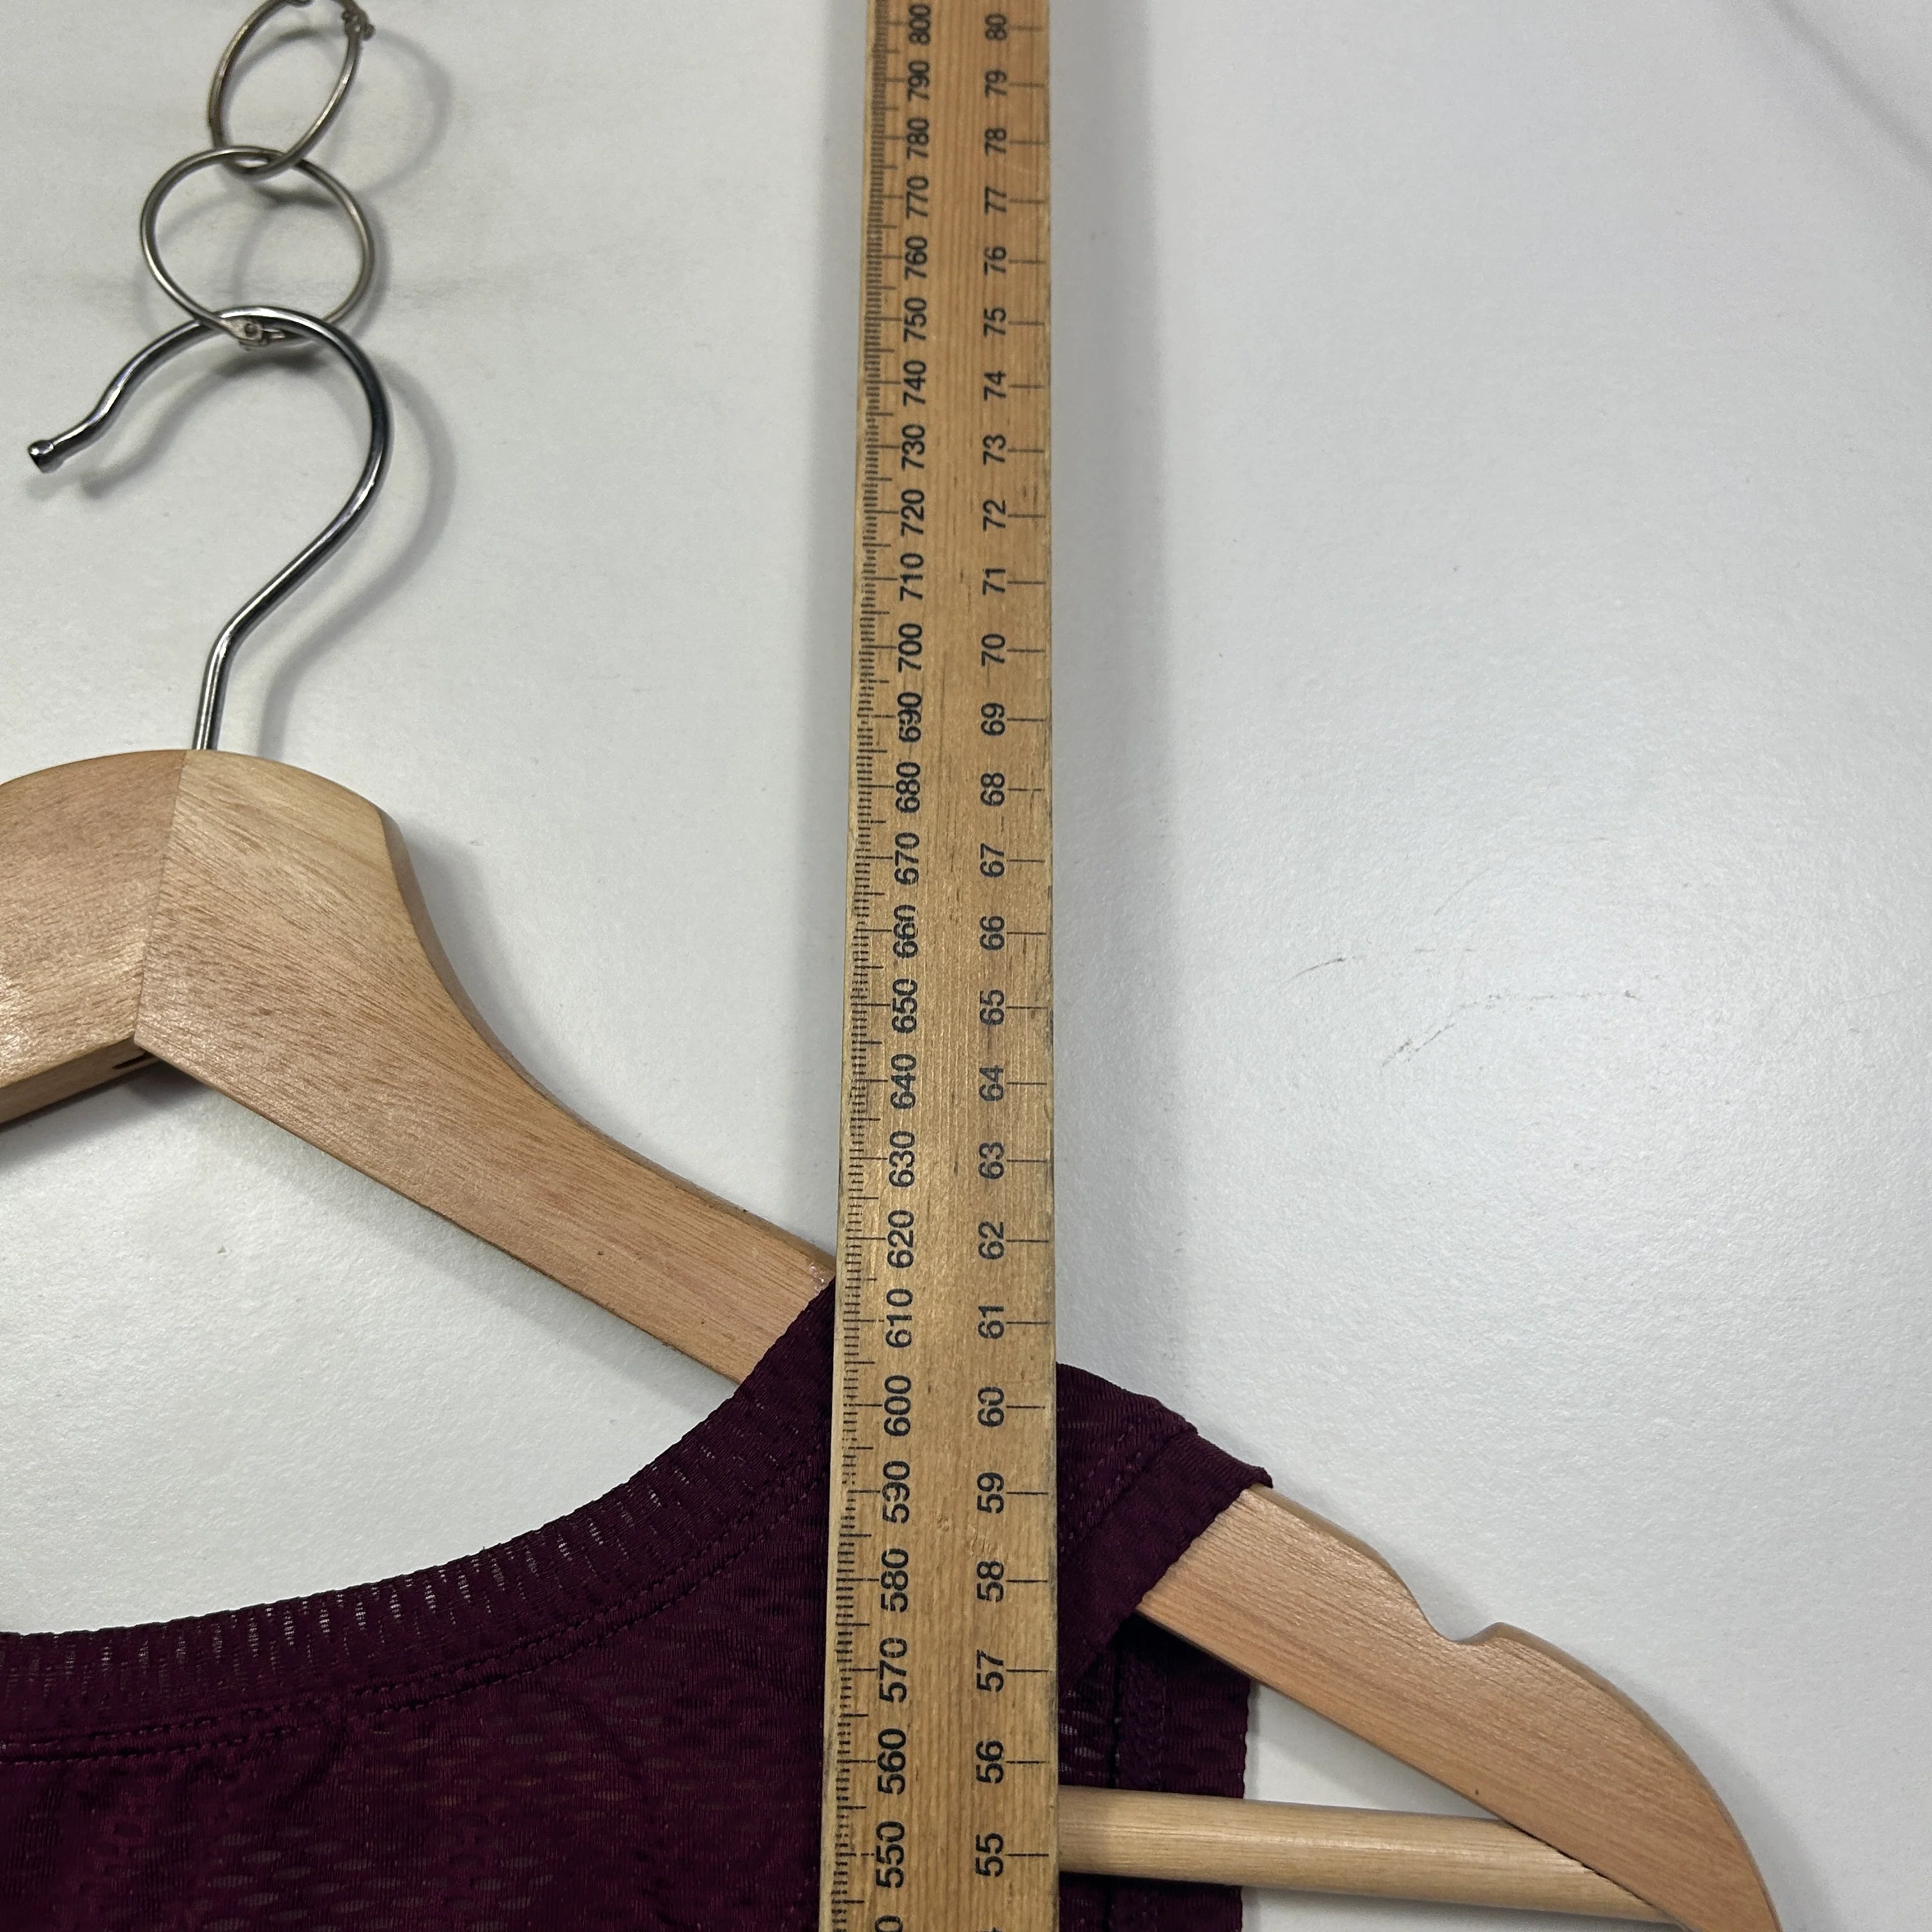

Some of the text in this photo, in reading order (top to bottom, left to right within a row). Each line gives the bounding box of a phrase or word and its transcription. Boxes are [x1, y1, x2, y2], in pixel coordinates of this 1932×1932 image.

[908, 4, 931, 45] 800
[985, 14, 1008, 40] 80
[907, 60, 930, 101] 790
[985, 70, 1008, 96] 79
[906, 118, 930, 160] 780
[985, 128, 1008, 155] 78
[905, 175, 929, 218] 770
[985, 186, 1008, 214] 77
[905, 236, 928, 280] 760
[984, 246, 1007, 275] 76
[903, 296, 927, 342] 750
[984, 307, 1007, 336] 75
[903, 359, 926, 406] 740
[983, 369, 1007, 400] 74
[902, 424, 925, 471] 730
[983, 434, 1007, 465] 73
[901, 489, 925, 537] 720
[983, 498, 1006, 530] 72
[900, 553, 924, 602] 710
[983, 567, 1006, 595] 71
[898, 623, 924, 672] 700
[981, 634, 1006, 666] 70
[898, 691, 923, 743] 690
[981, 702, 1006, 736] 69
[896, 762, 921, 813] 680
[981, 772, 1006, 806] 68
[894, 833, 919, 885] 670
[981, 843, 1005, 878] 67
[893, 904, 919, 958] 660
[980, 916, 1005, 951] 66
[892, 979, 917, 1032] 650
[980, 989, 1004, 1025] 65
[891, 1054, 917, 1109] 640
[979, 1066, 1004, 1101] 64
[889, 1131, 915, 1187] 630
[979, 1142, 1004, 1179] 63
[888, 1210, 914, 1268] 620
[979, 1222, 1004, 1259] 62
[887, 1289, 913, 1348] 610
[978, 1305, 1004, 1339] 61
[884, 1374, 912, 1436] 600
[978, 1386, 1004, 1427] 60
[882, 1460, 910, 1523] 590
[977, 1471, 1004, 1514] 59
[881, 1548, 909, 1613] 580
[977, 1560, 1004, 1602] 58
[879, 1637, 907, 1702] 570
[977, 1650, 1004, 1692] 57
[877, 1728, 907, 1795] 560
[976, 1740, 1004, 1783] 56
[877, 1821, 906, 1888] 550
[976, 1833, 1004, 1877] 55
